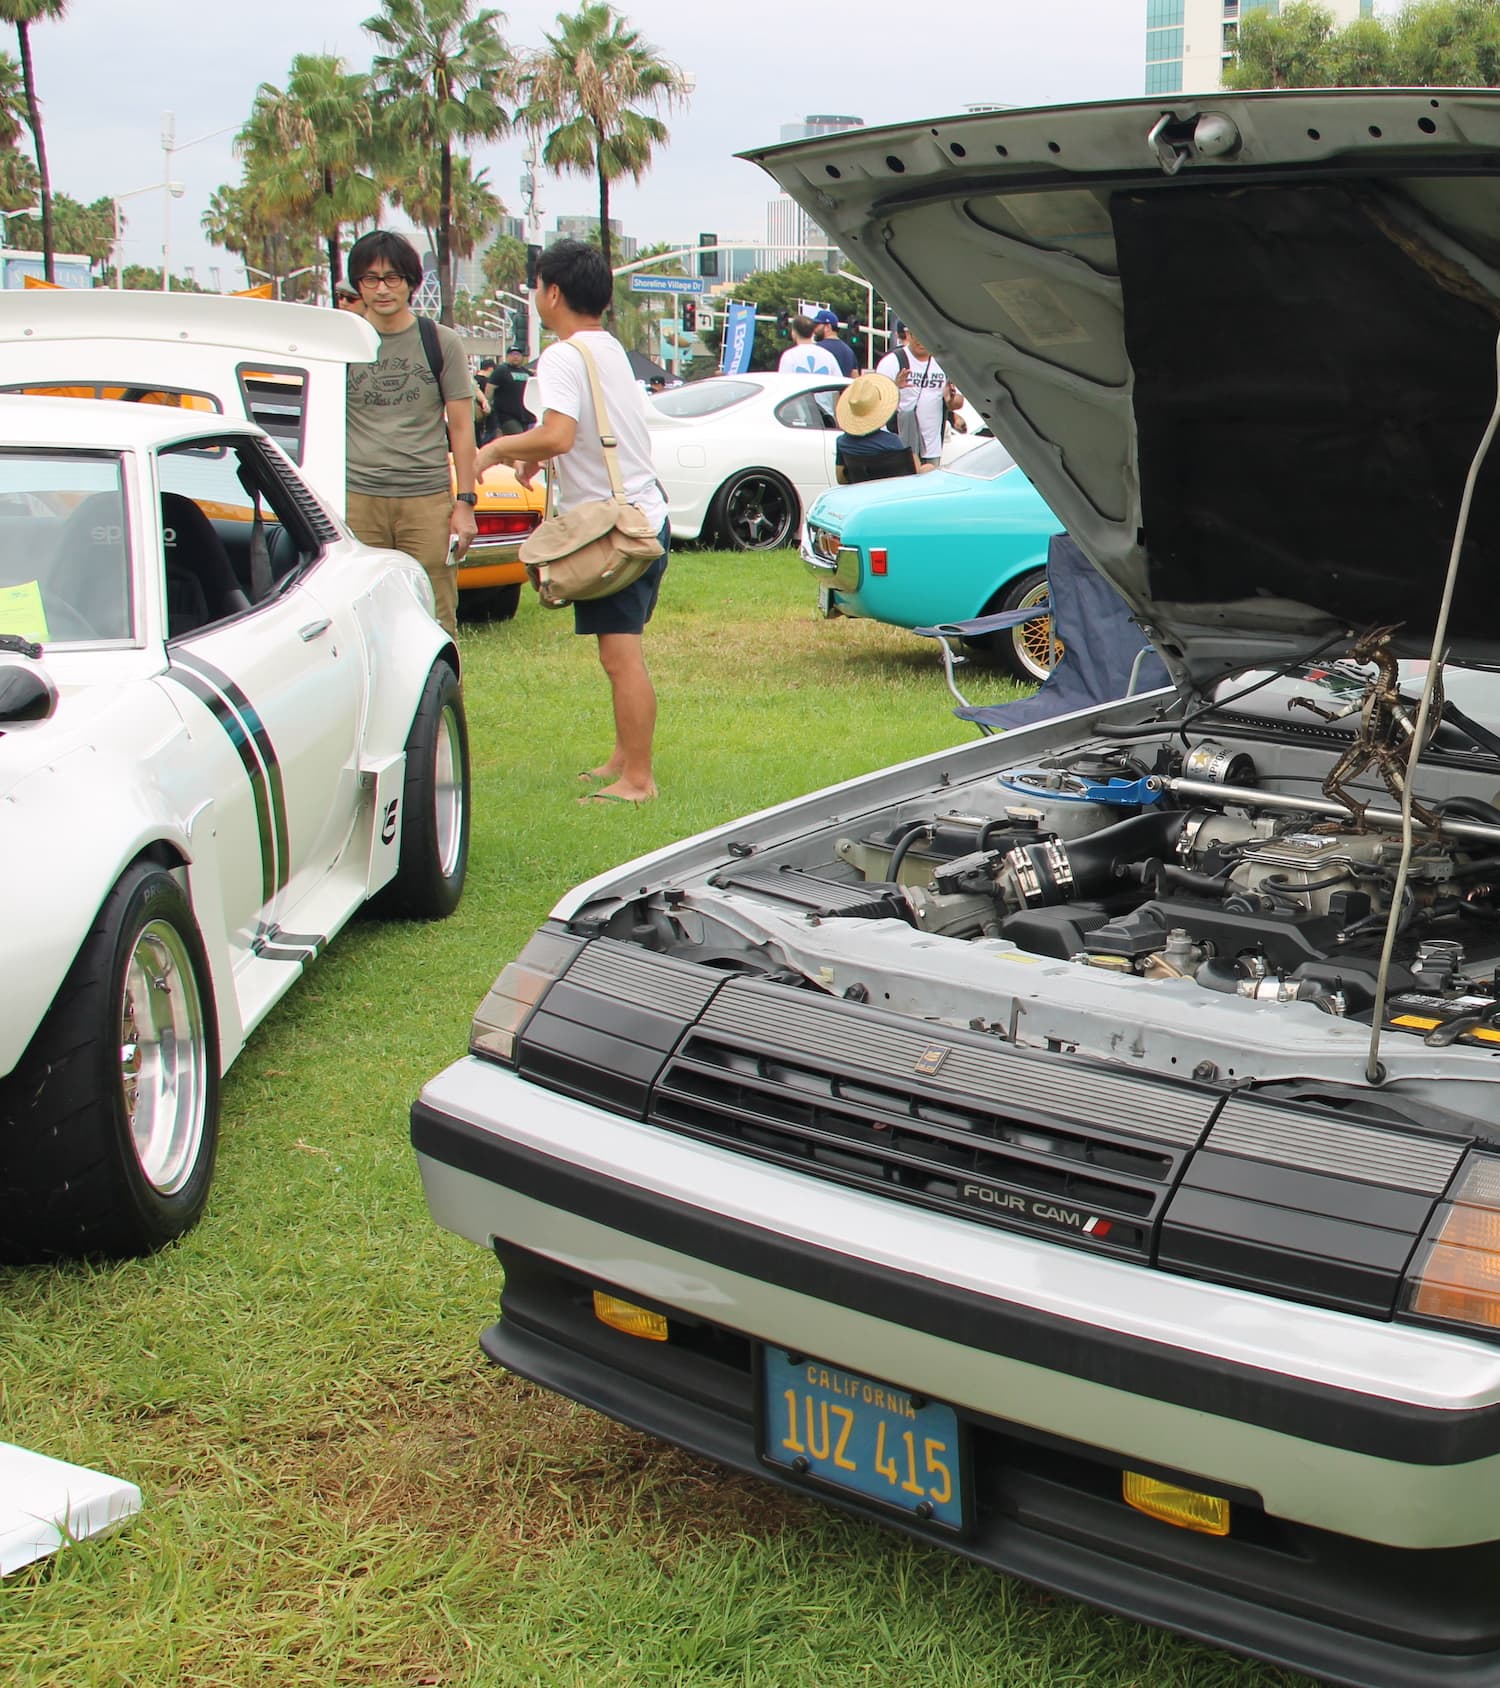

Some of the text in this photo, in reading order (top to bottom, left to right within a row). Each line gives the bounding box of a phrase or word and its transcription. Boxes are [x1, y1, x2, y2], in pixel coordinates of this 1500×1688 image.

[633, 278, 702, 292] Shoreline Village Dr
[963, 1184, 1080, 1227] FOUR CAM
[807, 1366, 916, 1420] CALIFORNIA
[782, 1388, 952, 1503] 1UZ 415
